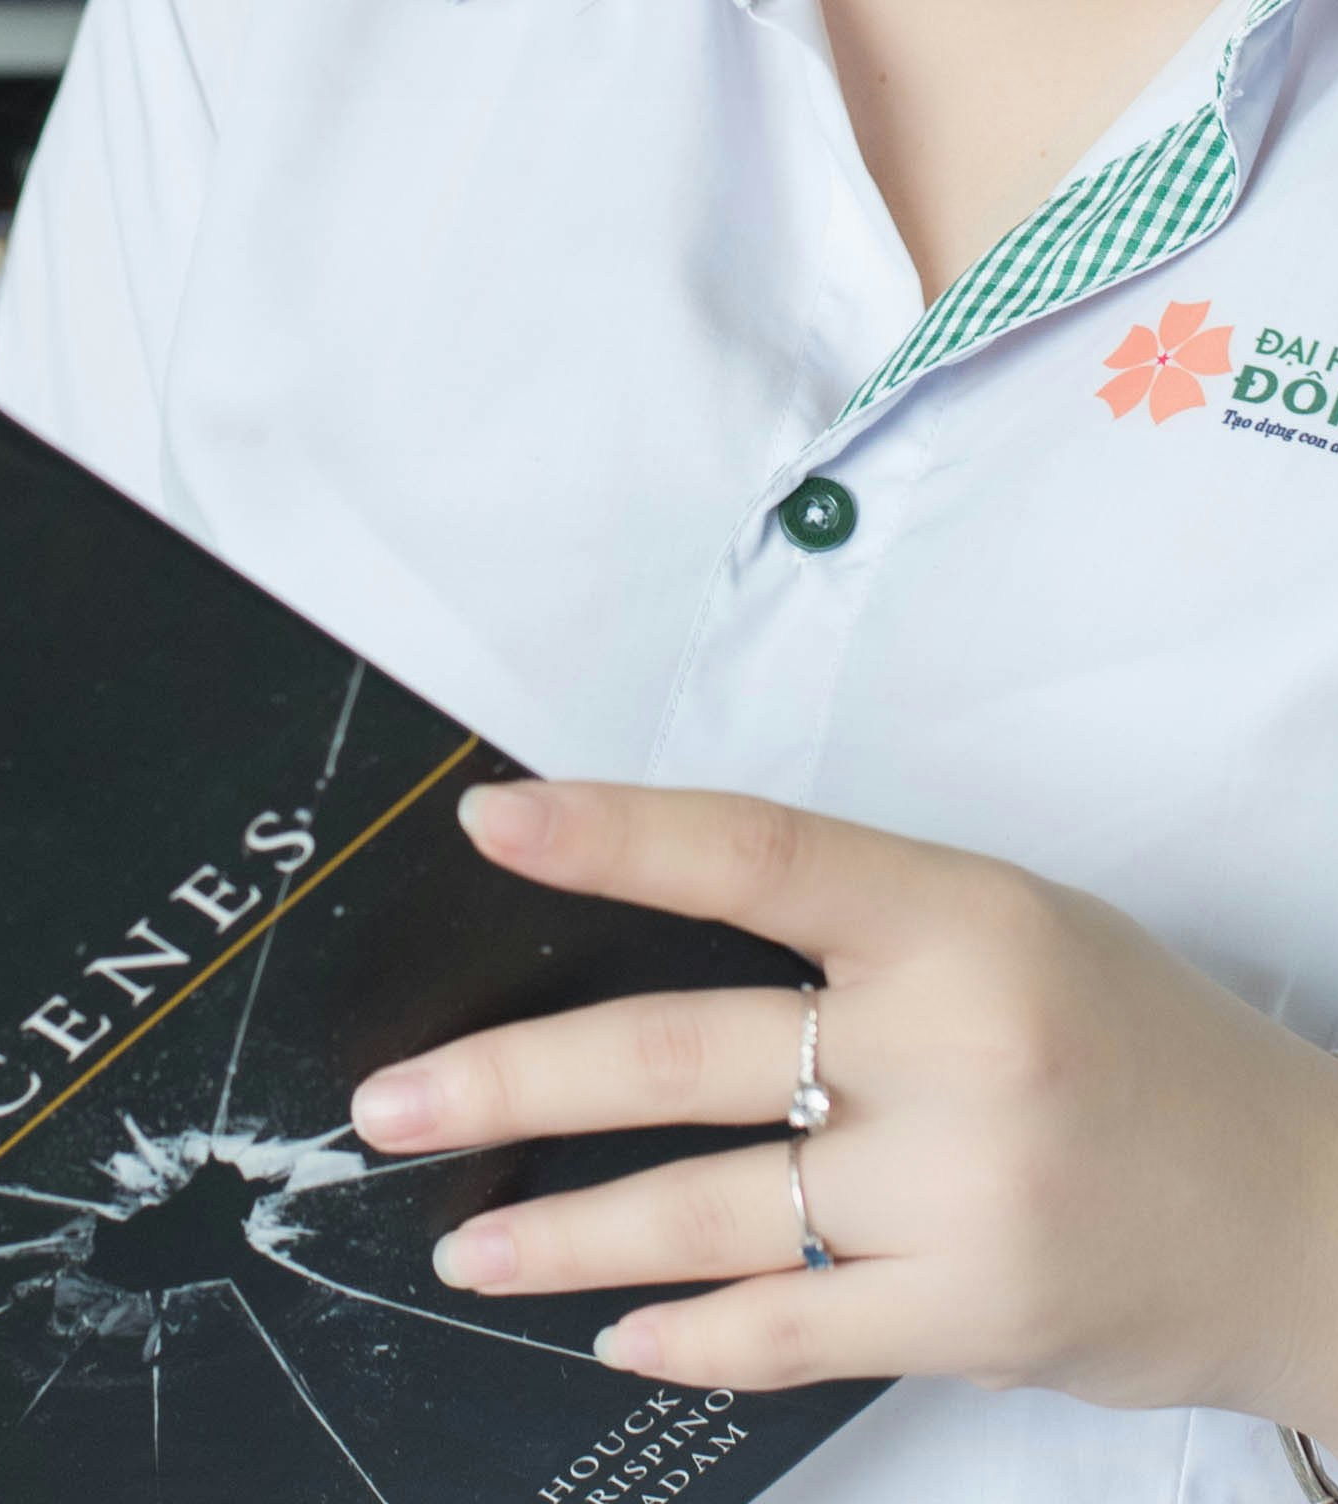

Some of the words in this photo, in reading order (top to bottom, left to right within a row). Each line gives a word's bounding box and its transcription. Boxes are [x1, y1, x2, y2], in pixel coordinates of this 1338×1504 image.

[1255, 327, 1320, 368] ĐẠI
[1222, 408, 1253, 432] Tạo
[1298, 430, 1328, 450] con
